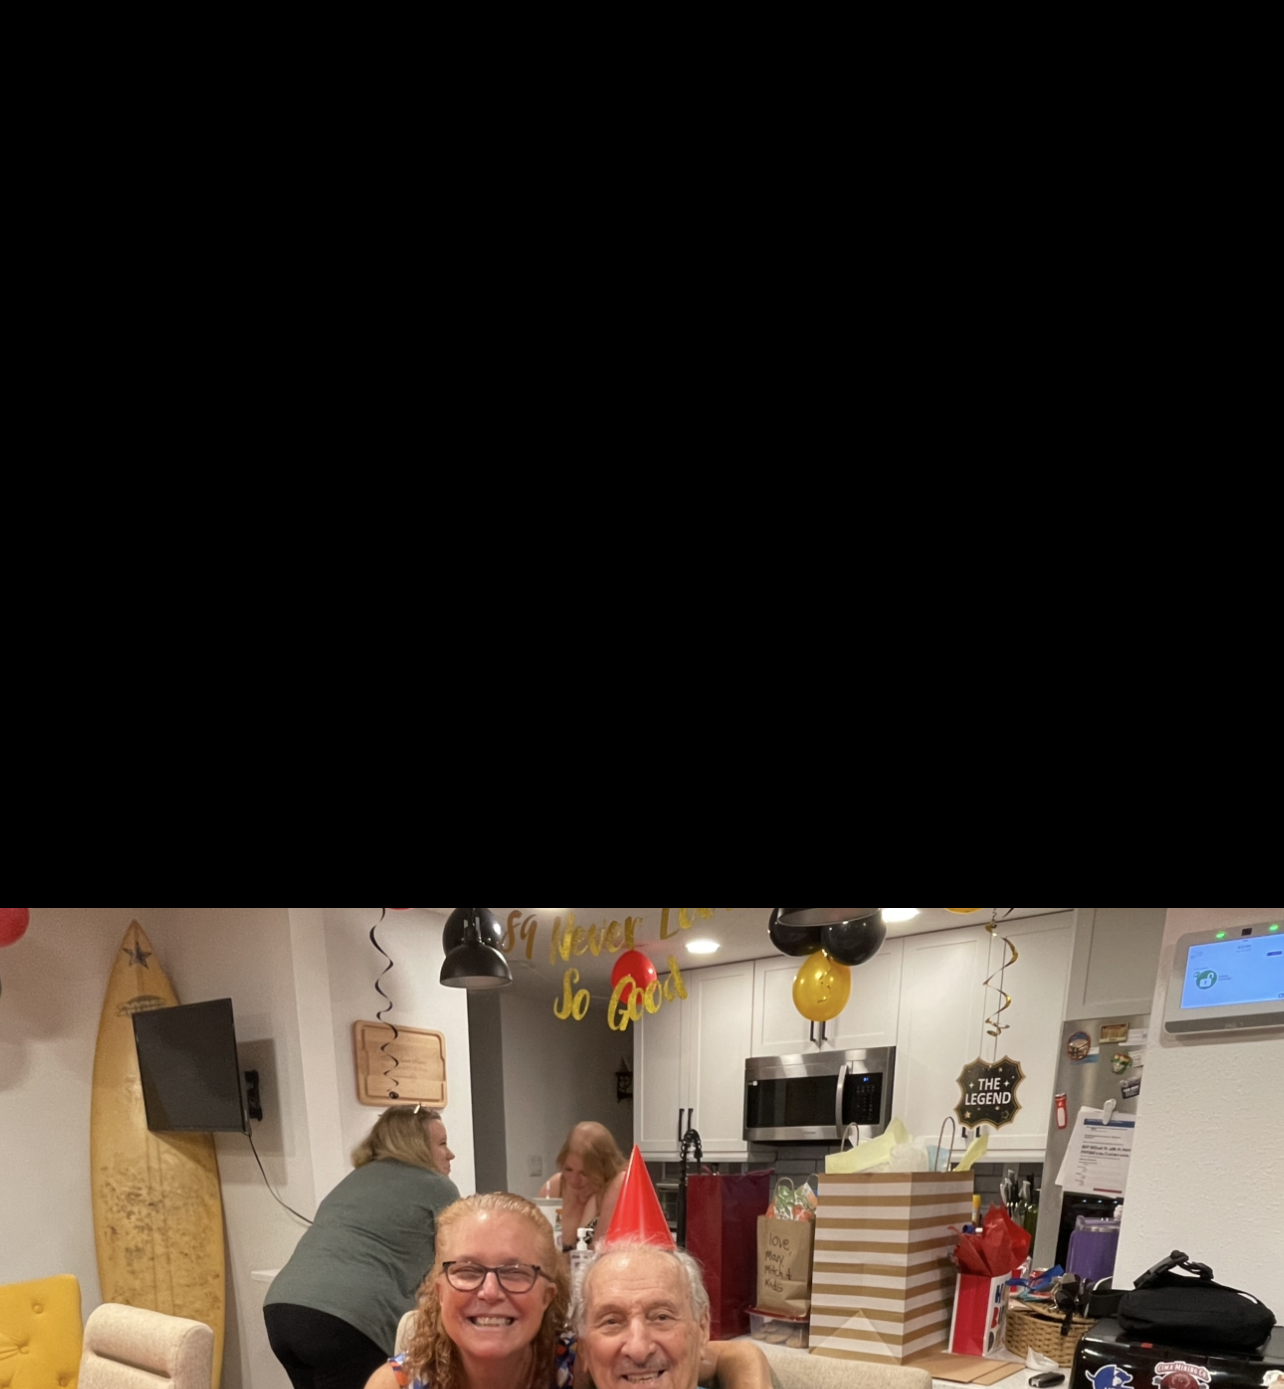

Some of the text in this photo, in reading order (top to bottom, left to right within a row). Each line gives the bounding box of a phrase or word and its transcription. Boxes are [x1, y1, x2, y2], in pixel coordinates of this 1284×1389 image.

[502, 910, 538, 960] 89
[549, 912, 643, 966] Never
[553, 954, 688, 1031] So Good
[965, 1091, 1012, 1106] LEGEND
[978, 1077, 1001, 1091] THE
